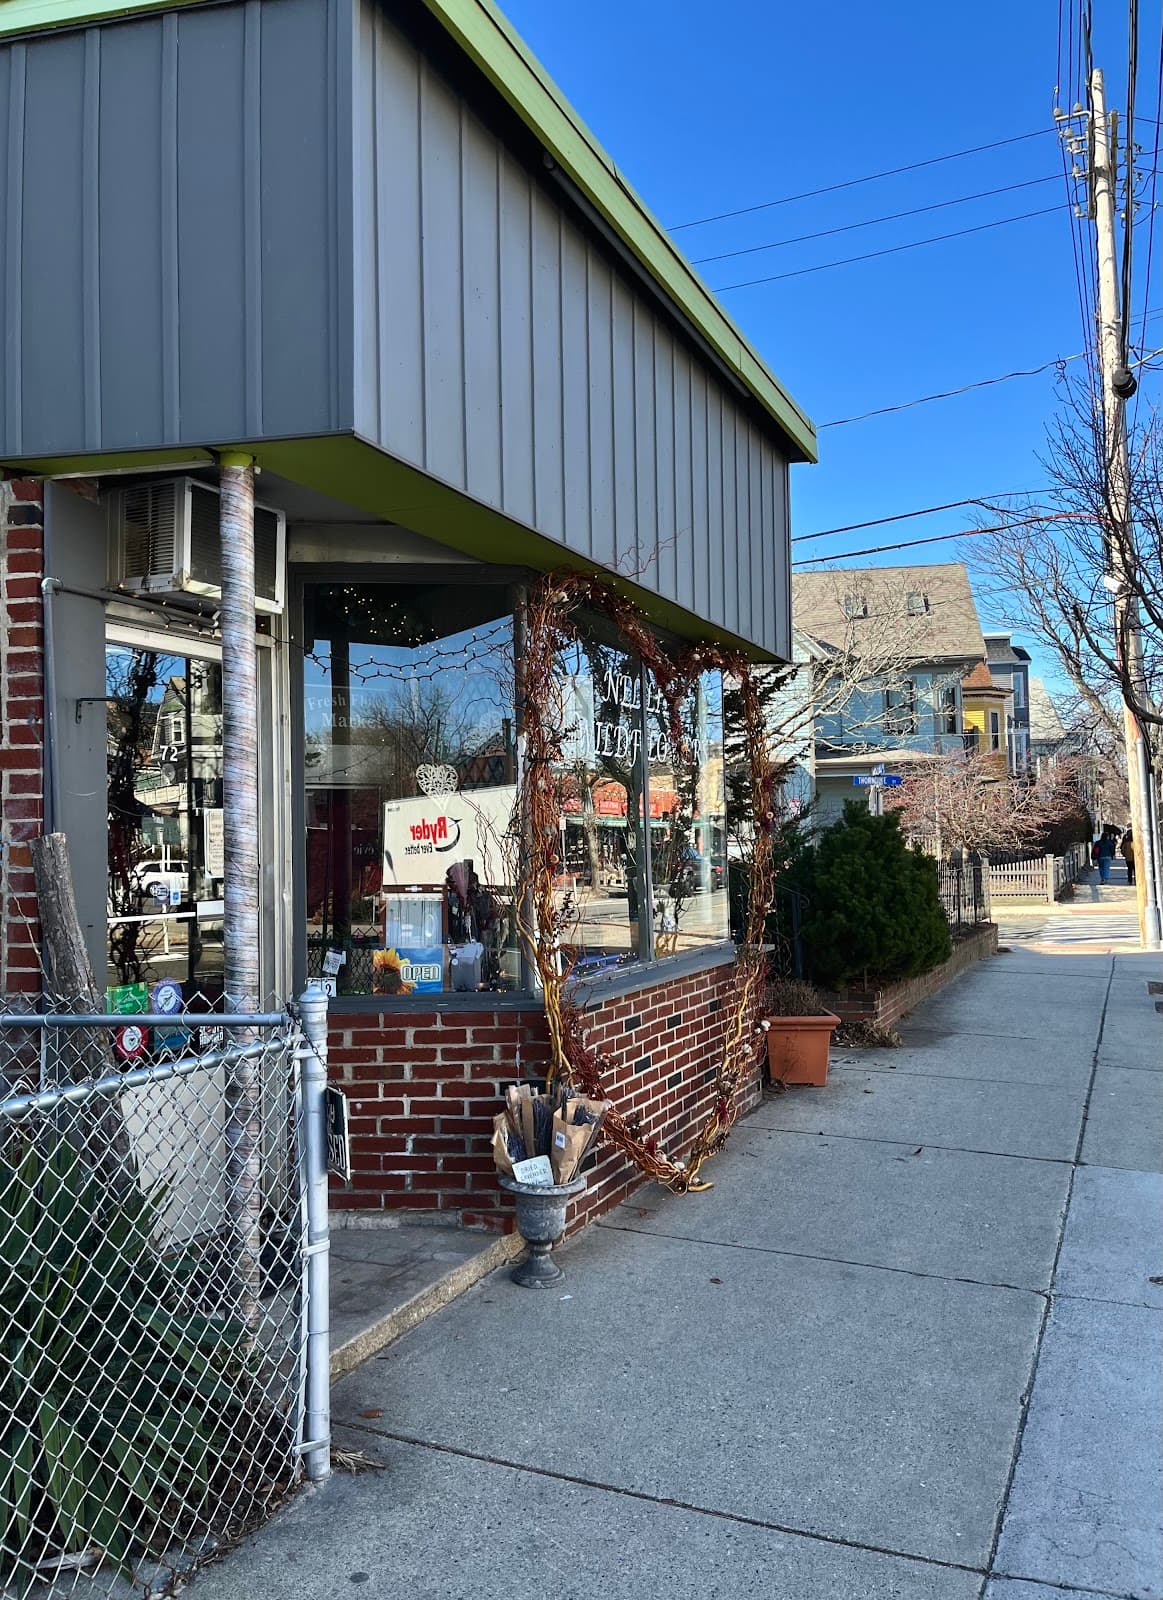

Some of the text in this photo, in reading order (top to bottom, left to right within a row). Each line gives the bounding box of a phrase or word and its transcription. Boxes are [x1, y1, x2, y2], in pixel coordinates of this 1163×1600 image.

[307, 693, 346, 710] Fresh
[159, 745, 178, 762] 72
[402, 965, 440, 981] OPEN
